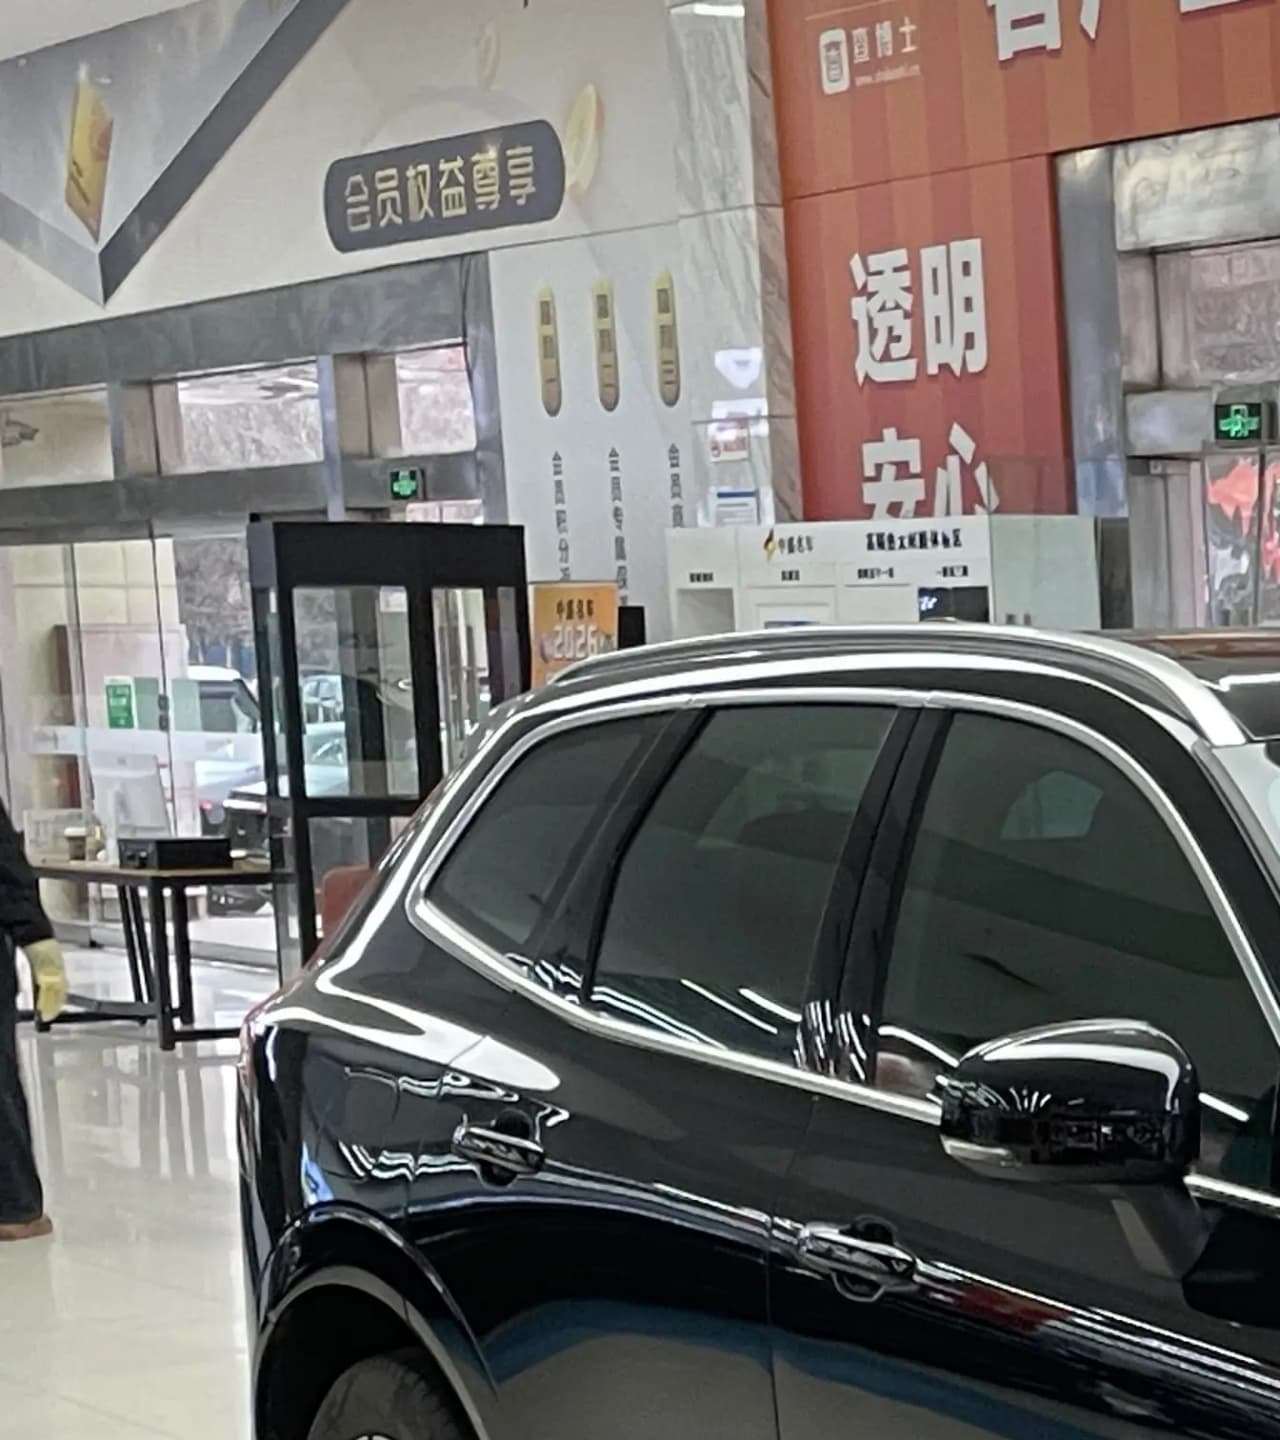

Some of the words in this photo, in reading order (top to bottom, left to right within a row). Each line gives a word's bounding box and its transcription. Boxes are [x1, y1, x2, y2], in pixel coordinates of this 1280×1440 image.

[344, 145, 537, 233] 会员权益尊享
[850, 238, 989, 388] 透明
[861, 422, 1000, 520] 安心
[553, 624, 598, 659] 2026
